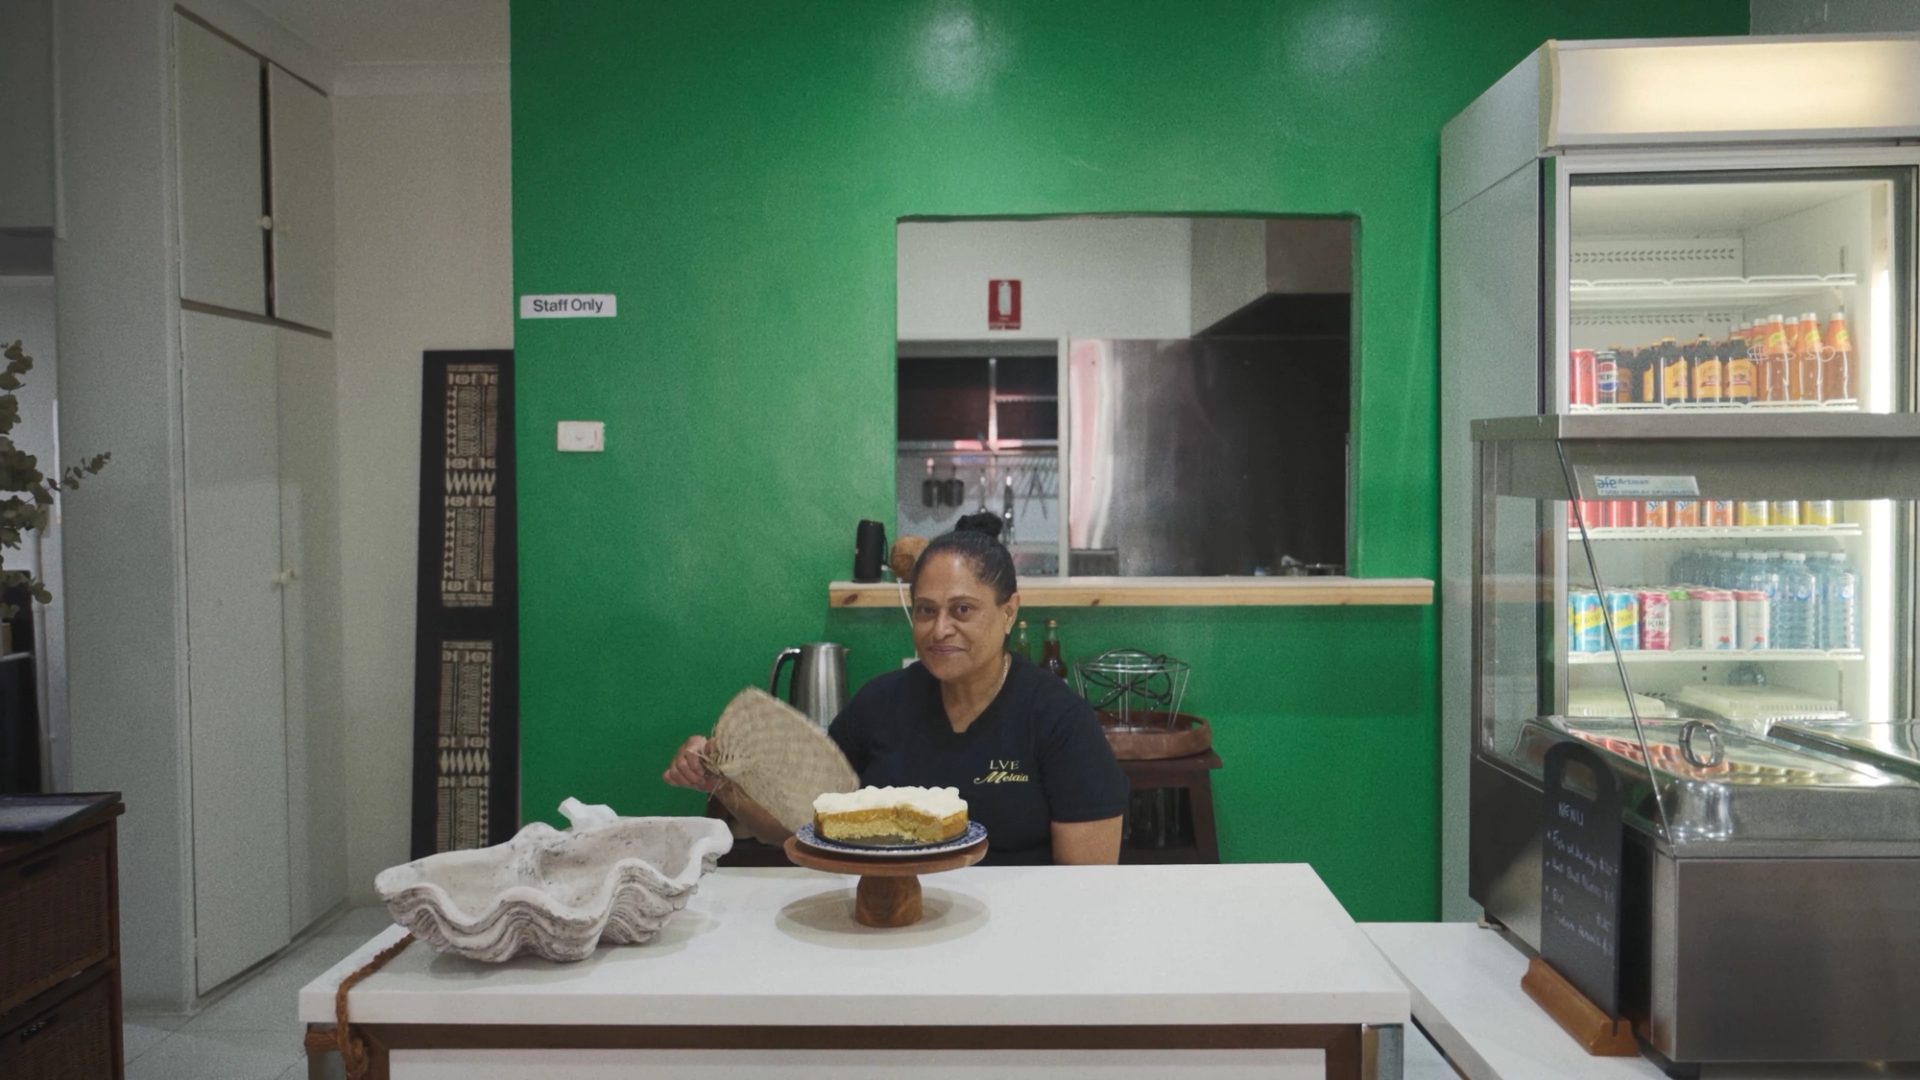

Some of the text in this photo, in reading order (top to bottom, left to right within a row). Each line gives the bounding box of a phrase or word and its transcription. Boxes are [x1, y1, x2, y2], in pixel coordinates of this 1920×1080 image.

[533, 298, 604, 314] Staff Only
[989, 760, 1020, 770] LVE
